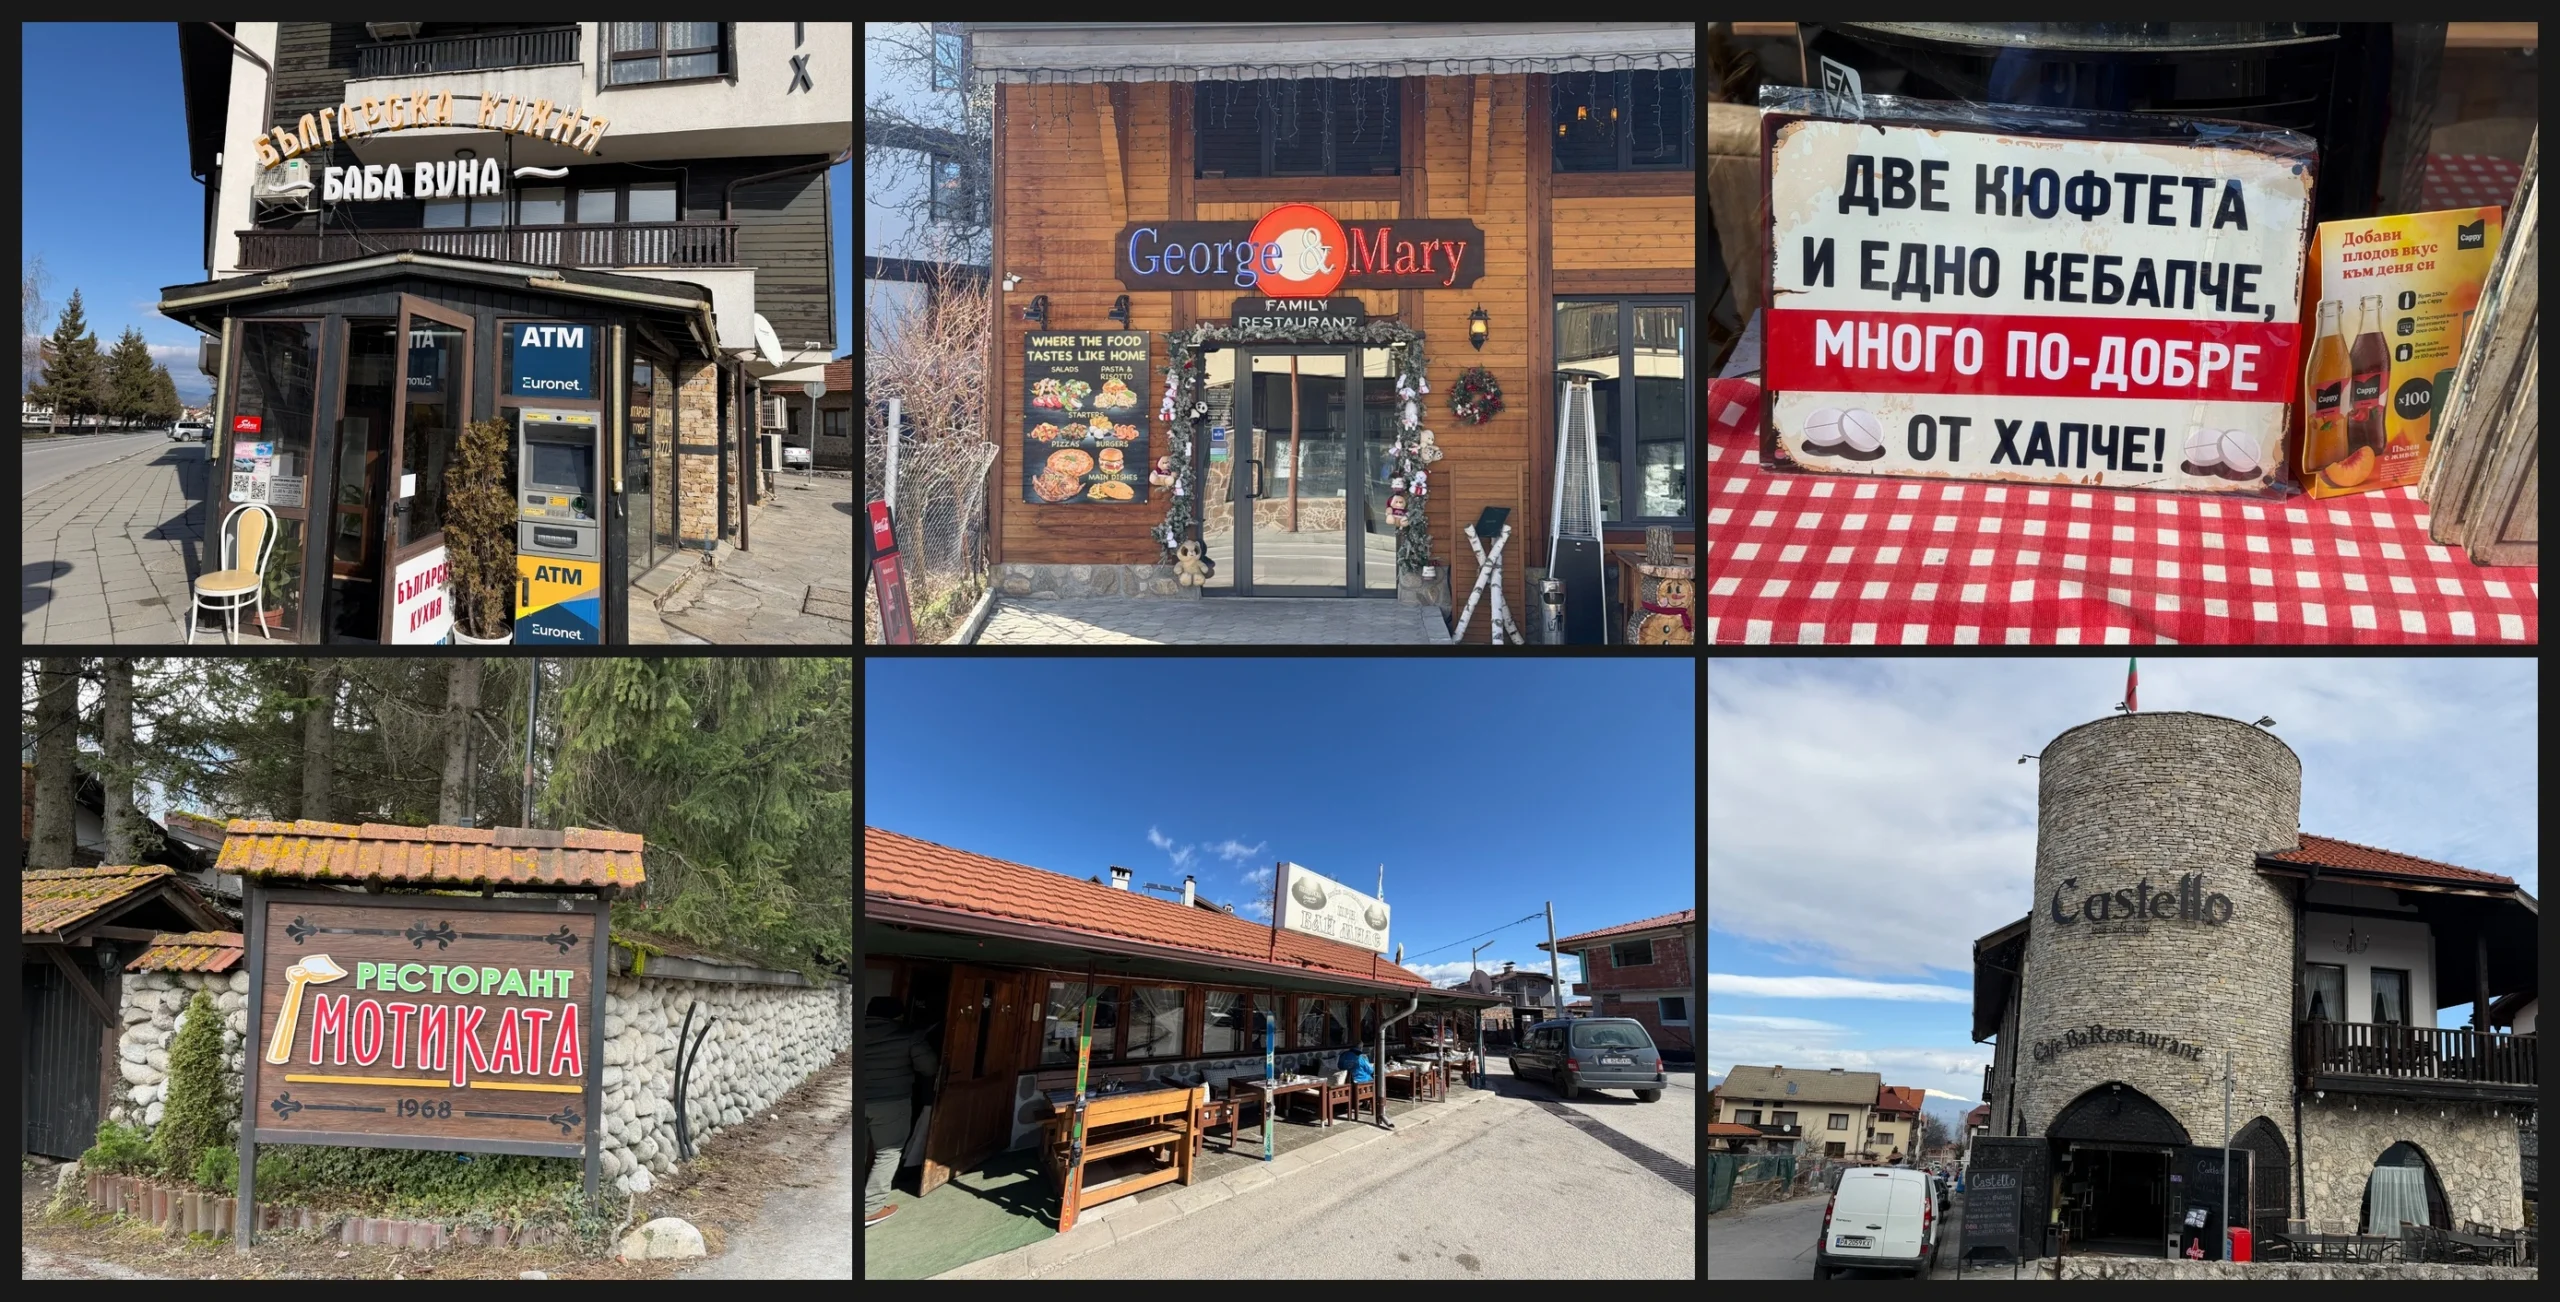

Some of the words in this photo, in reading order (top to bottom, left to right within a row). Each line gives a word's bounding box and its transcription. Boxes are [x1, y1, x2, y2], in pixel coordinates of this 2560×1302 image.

[253, 89, 454, 170] БЪЛГАРСКА
[478, 90, 611, 155] КУХНЯ
[323, 163, 404, 200] БАБА
[414, 157, 500, 199] ВУНА
[1839, 154, 1949, 216] ДВЕ
[1975, 163, 2248, 231] КЮФТЕТА
[2343, 230, 2402, 248] Добави
[2460, 233, 2482, 242] Cappy
[1129, 228, 1283, 287] George
[1299, 227, 1335, 274] &
[1350, 227, 1466, 286] Mary
[2343, 249, 2399, 262] плодов
[2402, 244, 2438, 257] вкус
[1803, 237, 1834, 288] И
[1860, 240, 2000, 302] ЕДНО
[2024, 250, 2275, 322] КЕБАПЧЕ,
[2343, 267, 2374, 279] към
[2376, 263, 2414, 277] деня
[2417, 260, 2435, 271] си
[1266, 300, 1328, 311] FAMILY
[1239, 316, 1356, 329] RESTAURANT
[521, 326, 583, 348] ATM
[1032, 336, 1075, 347] WHERE
[1080, 336, 1102, 346] THE
[1107, 335, 1142, 346] FOOD
[1027, 351, 1073, 361] TASTES
[1078, 351, 1105, 361] LIKE
[1110, 350, 1146, 361] HOME
[1815, 319, 1983, 375] МНОГО
[2006, 330, 2260, 392] ПО-ДОБРЕ
[2318, 394, 2338, 403] Cappy
[2356, 387, 2378, 395] Cappy
[1068, 411, 1104, 419] STARTERS
[1907, 414, 1971, 462] ОТ
[1990, 418, 2166, 472] ХАПЧЕ!
[2392, 444, 2419, 453] Пълен
[2391, 451, 2419, 460] живот
[397, 561, 453, 604] БЪЛГАРСК
[535, 565, 582, 586] ATM
[410, 597, 442, 633] КУХНЯ
[2052, 872, 2234, 925] Castello
[1300, 910, 1335, 936] БАЙ
[356, 962, 573, 998] РЕСТОРАНТ
[309, 993, 583, 1086] МОТИКАТА
[2034, 1040, 2063, 1061] Cafe
[397, 1099, 452, 1119] 1968
[1972, 1173, 2016, 1187] Castello
